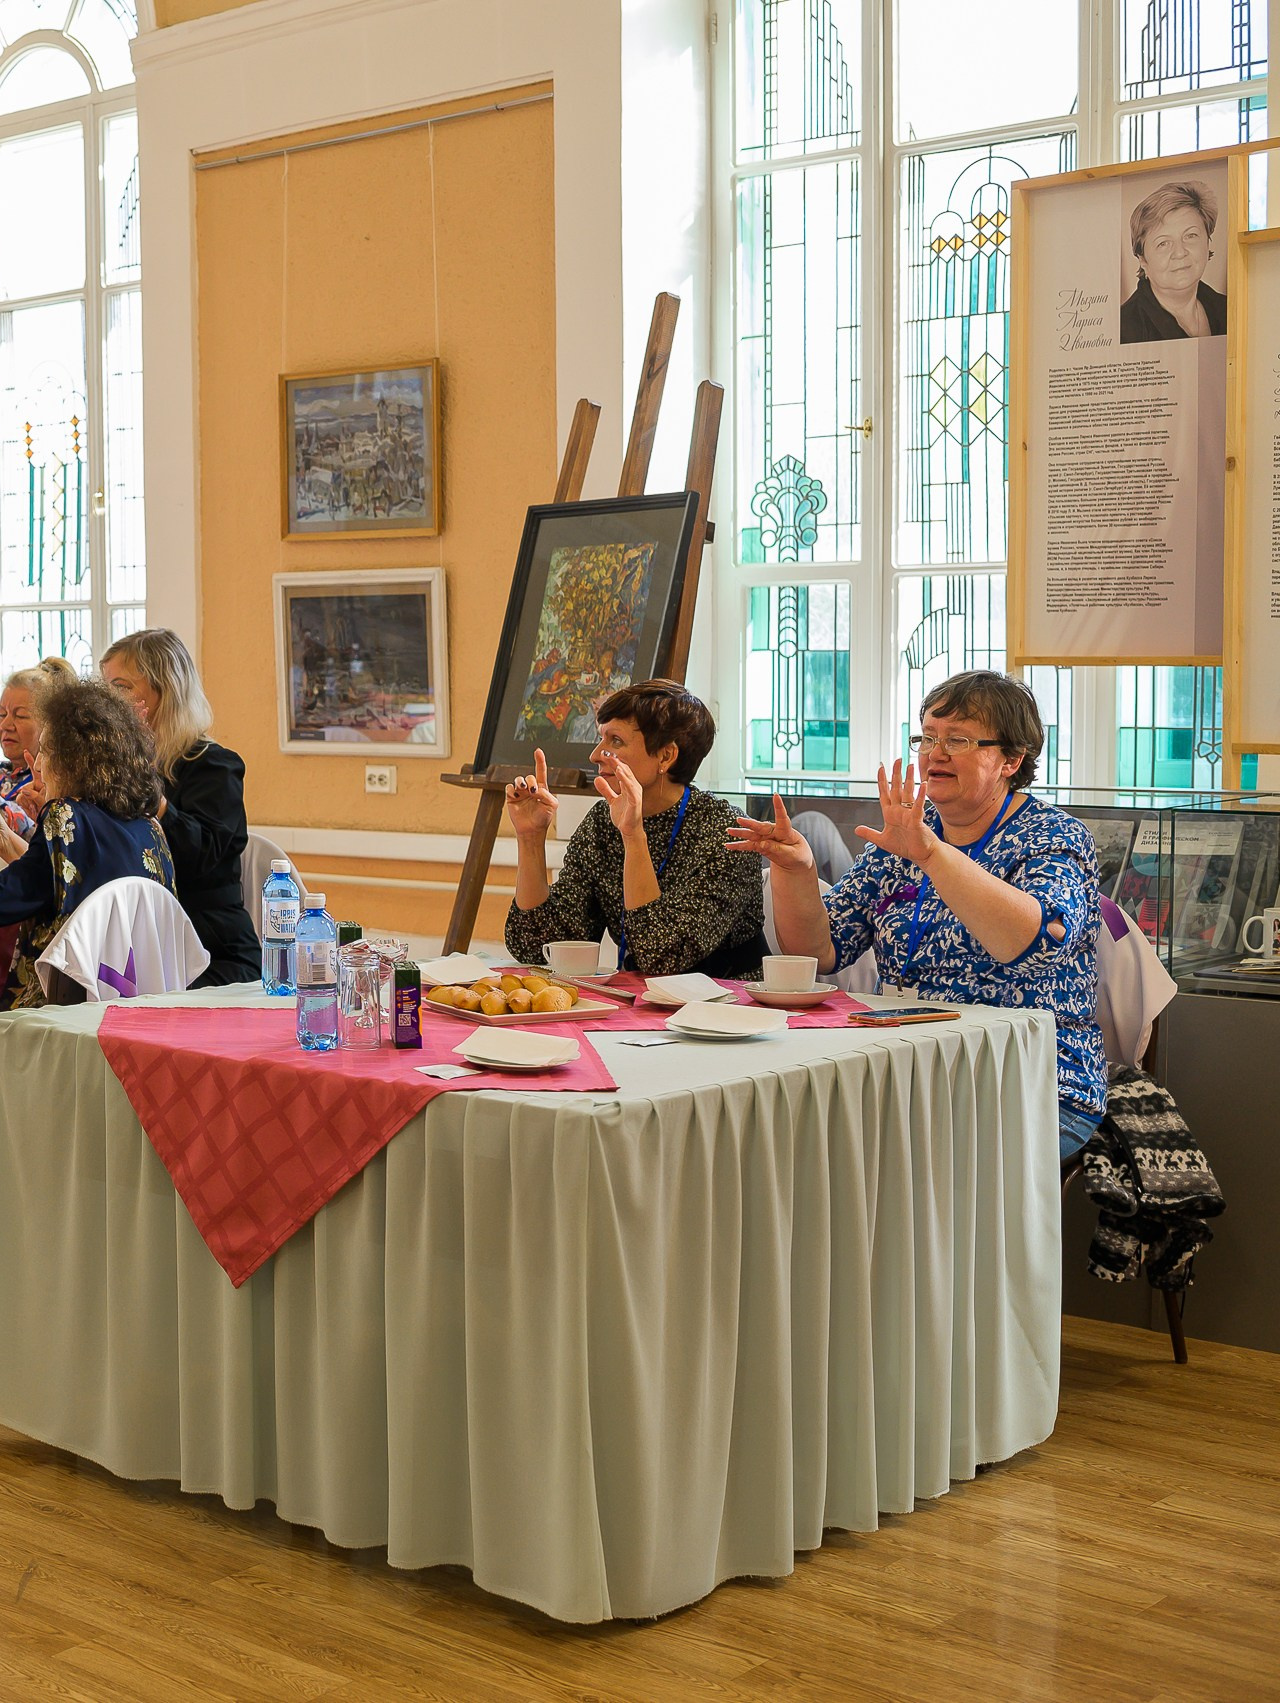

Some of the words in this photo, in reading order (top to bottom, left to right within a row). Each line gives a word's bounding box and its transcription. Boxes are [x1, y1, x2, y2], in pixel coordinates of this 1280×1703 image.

[1056, 288, 1109, 312] Мызина
[1056, 311, 1103, 334] Лариса
[1059, 333, 1112, 351] Ивановна
